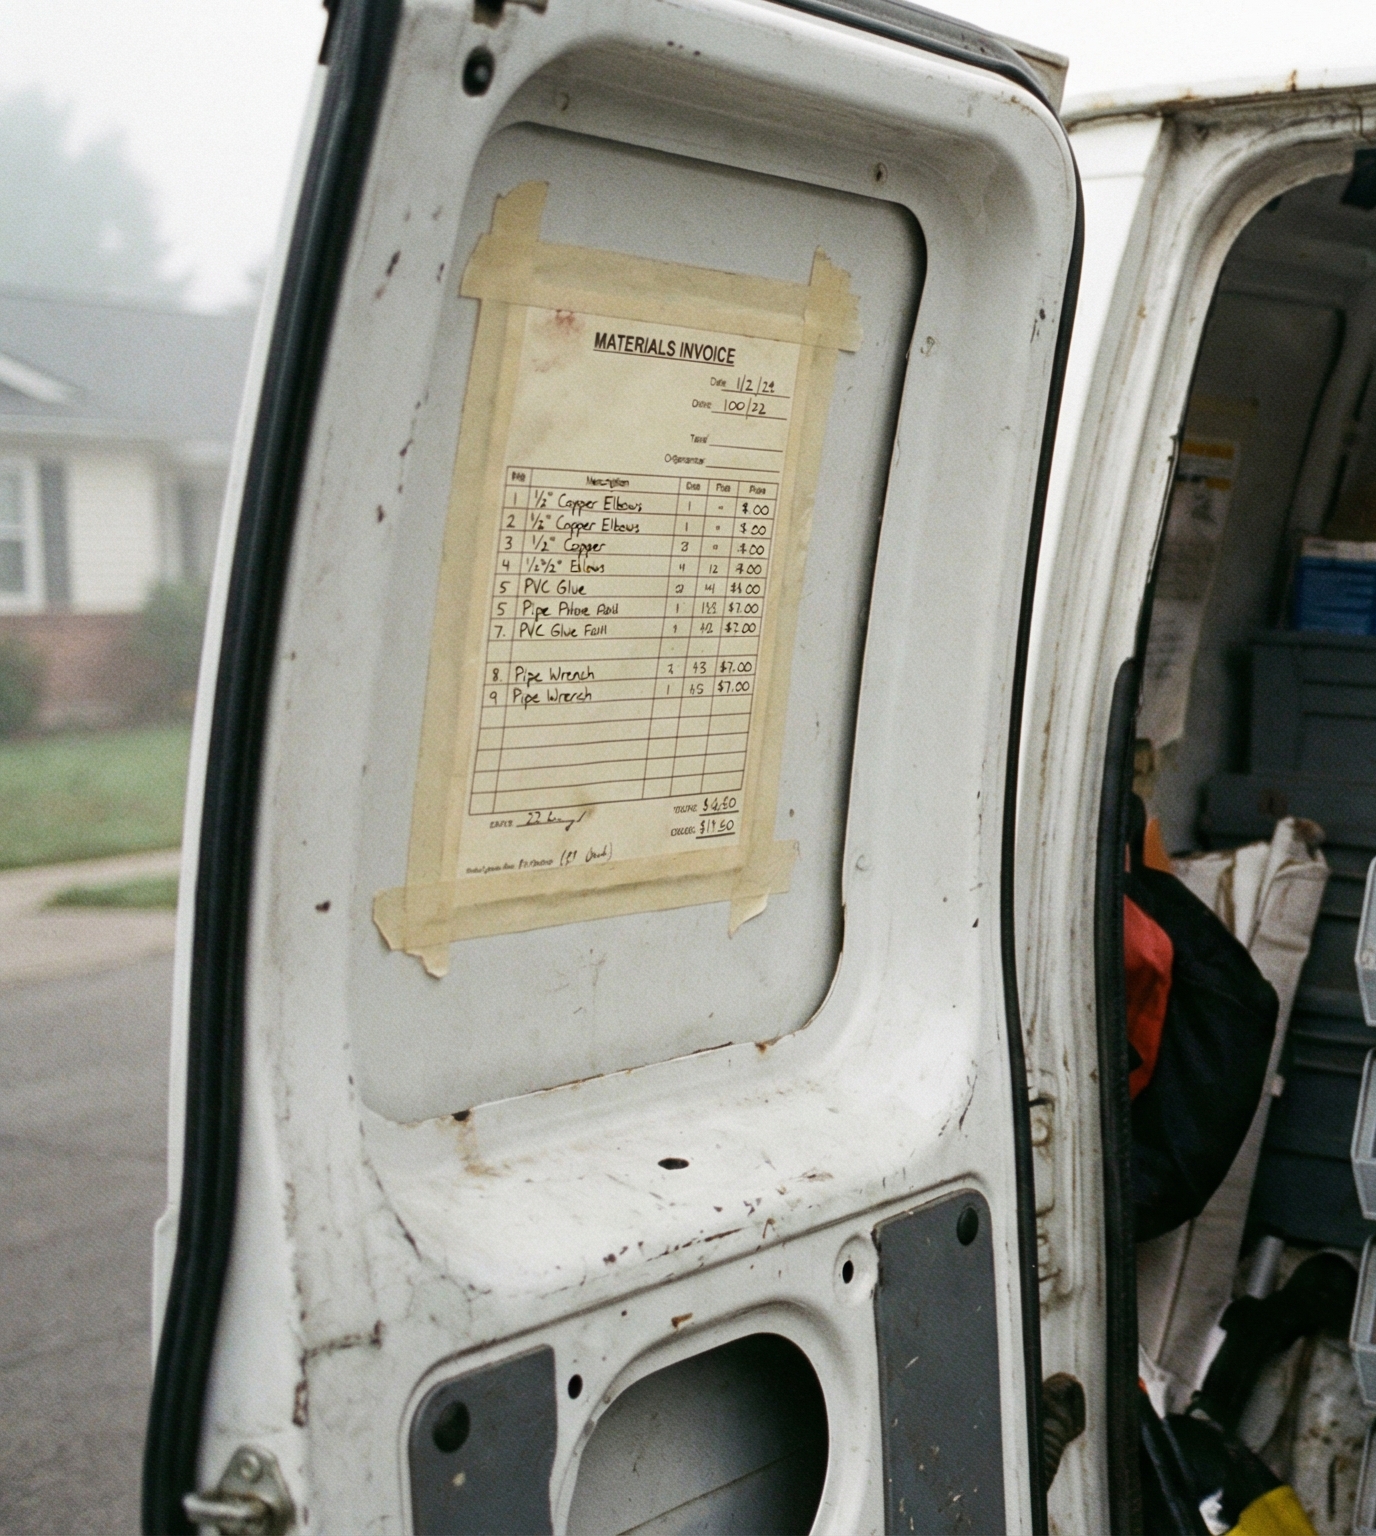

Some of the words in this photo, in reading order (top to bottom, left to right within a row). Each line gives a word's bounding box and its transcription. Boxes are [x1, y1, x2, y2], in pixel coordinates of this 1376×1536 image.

[594, 332, 675, 357] MATERIALS
[680, 342, 736, 364] INVOICE
[558, 493, 598, 516] Copper
[506, 514, 516, 528] 2
[556, 514, 597, 537] Copper
[504, 536, 513, 550] 3
[502, 560, 510, 572] 4
[500, 581, 511, 594] 5
[524, 578, 550, 595] PVC
[557, 579, 587, 595] Glue
[497, 602, 508, 616] 5
[523, 599, 551, 622] Pipe
[520, 622, 545, 640] PVC
[551, 623, 578, 638] Glue
[515, 665, 543, 688] Pipe
[550, 665, 595, 682] Wrench
[513, 687, 540, 710] Pipe
